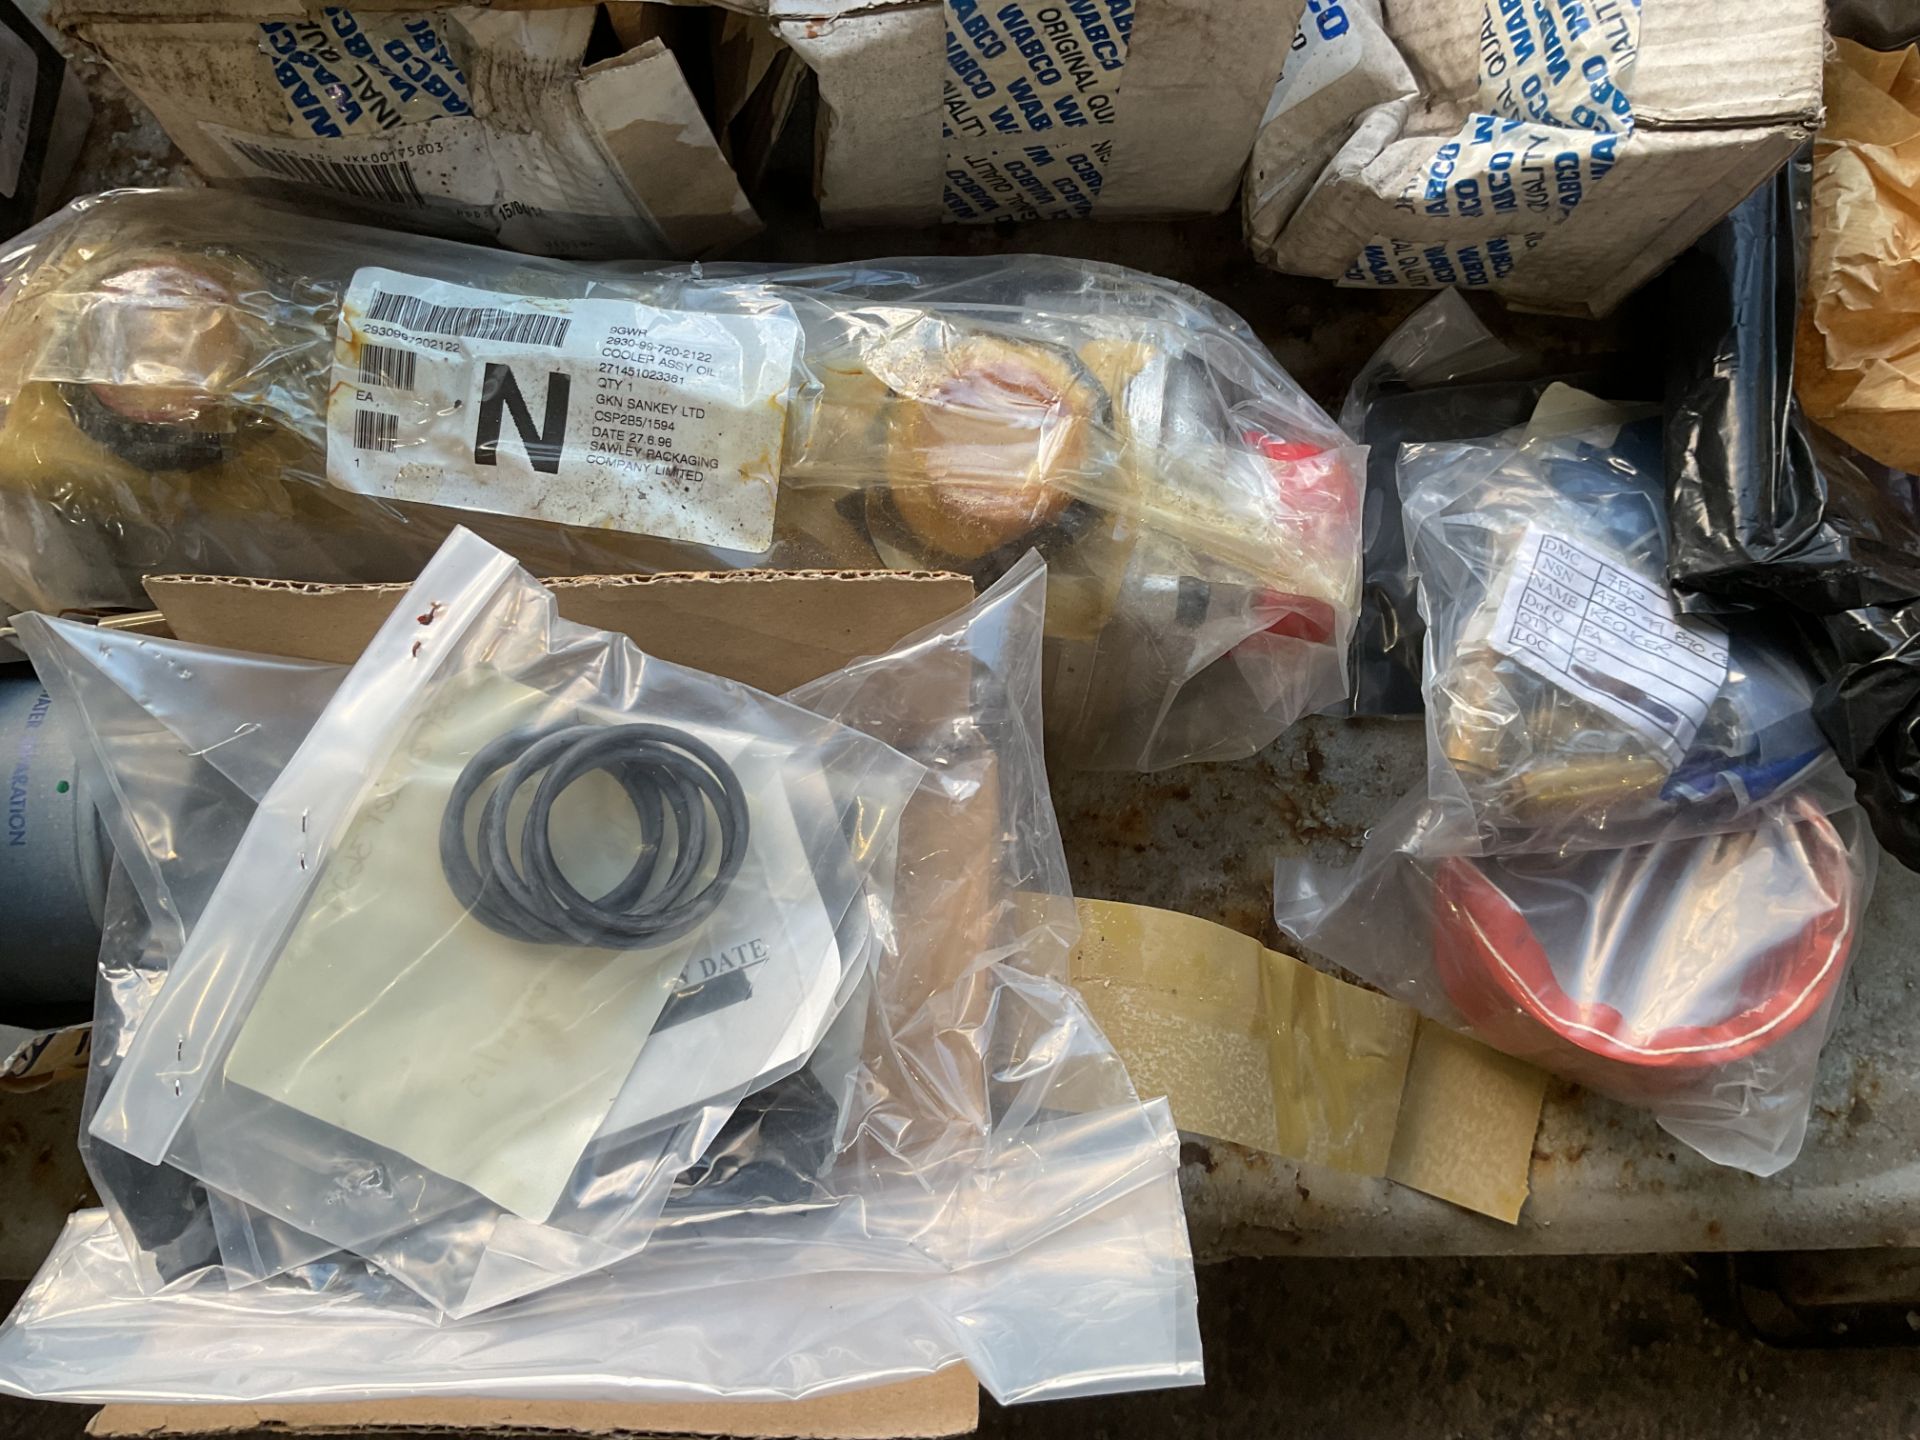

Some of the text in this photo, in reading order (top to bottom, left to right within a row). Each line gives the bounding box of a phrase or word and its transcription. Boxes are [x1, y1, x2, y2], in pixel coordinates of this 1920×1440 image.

[949, 0, 1007, 59] ABCO
[997, 3, 1062, 86] WABCO
[1037, 7, 1098, 93] ORIGINAL
[384, 39, 474, 120] ABCO
[1425, 143, 1461, 217] ABCO
[602, 347, 717, 377] COOLER ASSY OIL
[606, 337, 713, 363] 2930-99-720-2122
[356, 390, 374, 402] EA
[598, 377, 633, 392] QTY 1
[475, 363, 571, 475] N
[596, 394, 705, 419] GKN SANKEY LTD
[592, 426, 672, 448] DATE 27.6.96
[354, 458, 360, 468] 1
[586, 454, 704, 482] COMPANY LIMITED
[590, 441, 719, 469] SAWLEY PACKAGING
[1544, 540, 1582, 566] DMC
[1542, 558, 1574, 584] NSN
[1531, 575, 1579, 608] NAME
[1520, 612, 1553, 633] QTY
[1583, 624, 1602, 645] EA
[1513, 626, 1548, 652] LOC
[698, 938, 768, 979] DATE
